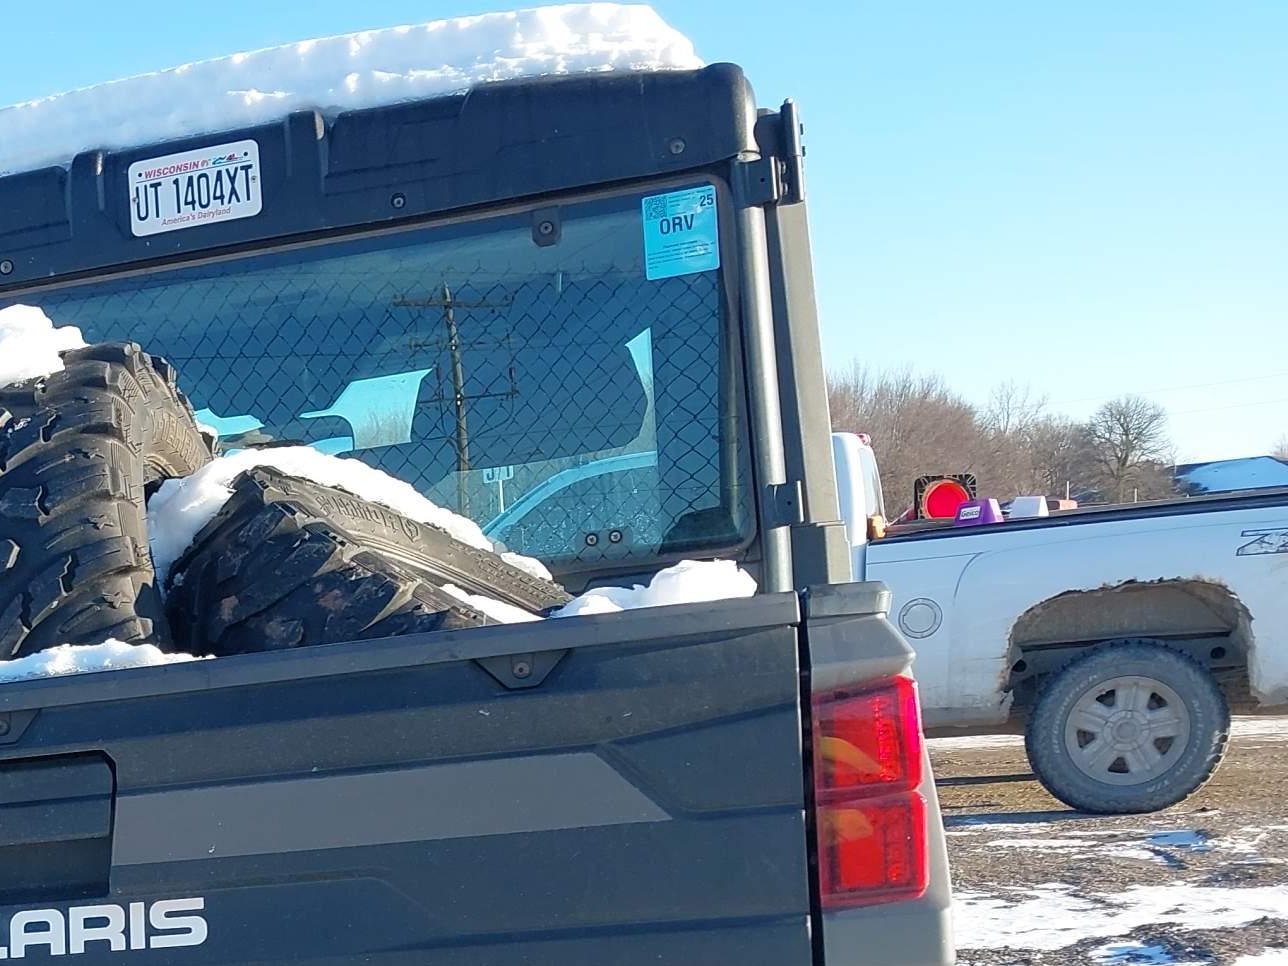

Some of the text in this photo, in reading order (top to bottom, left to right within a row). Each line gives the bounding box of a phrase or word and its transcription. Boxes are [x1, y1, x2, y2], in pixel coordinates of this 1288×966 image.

[144, 161, 200, 179] WISCONSIN
[135, 164, 253, 221] UT 1404XT
[699, 193, 714, 207] 25
[162, 206, 232, 227] America's Dairyland
[659, 213, 695, 235] ORV
